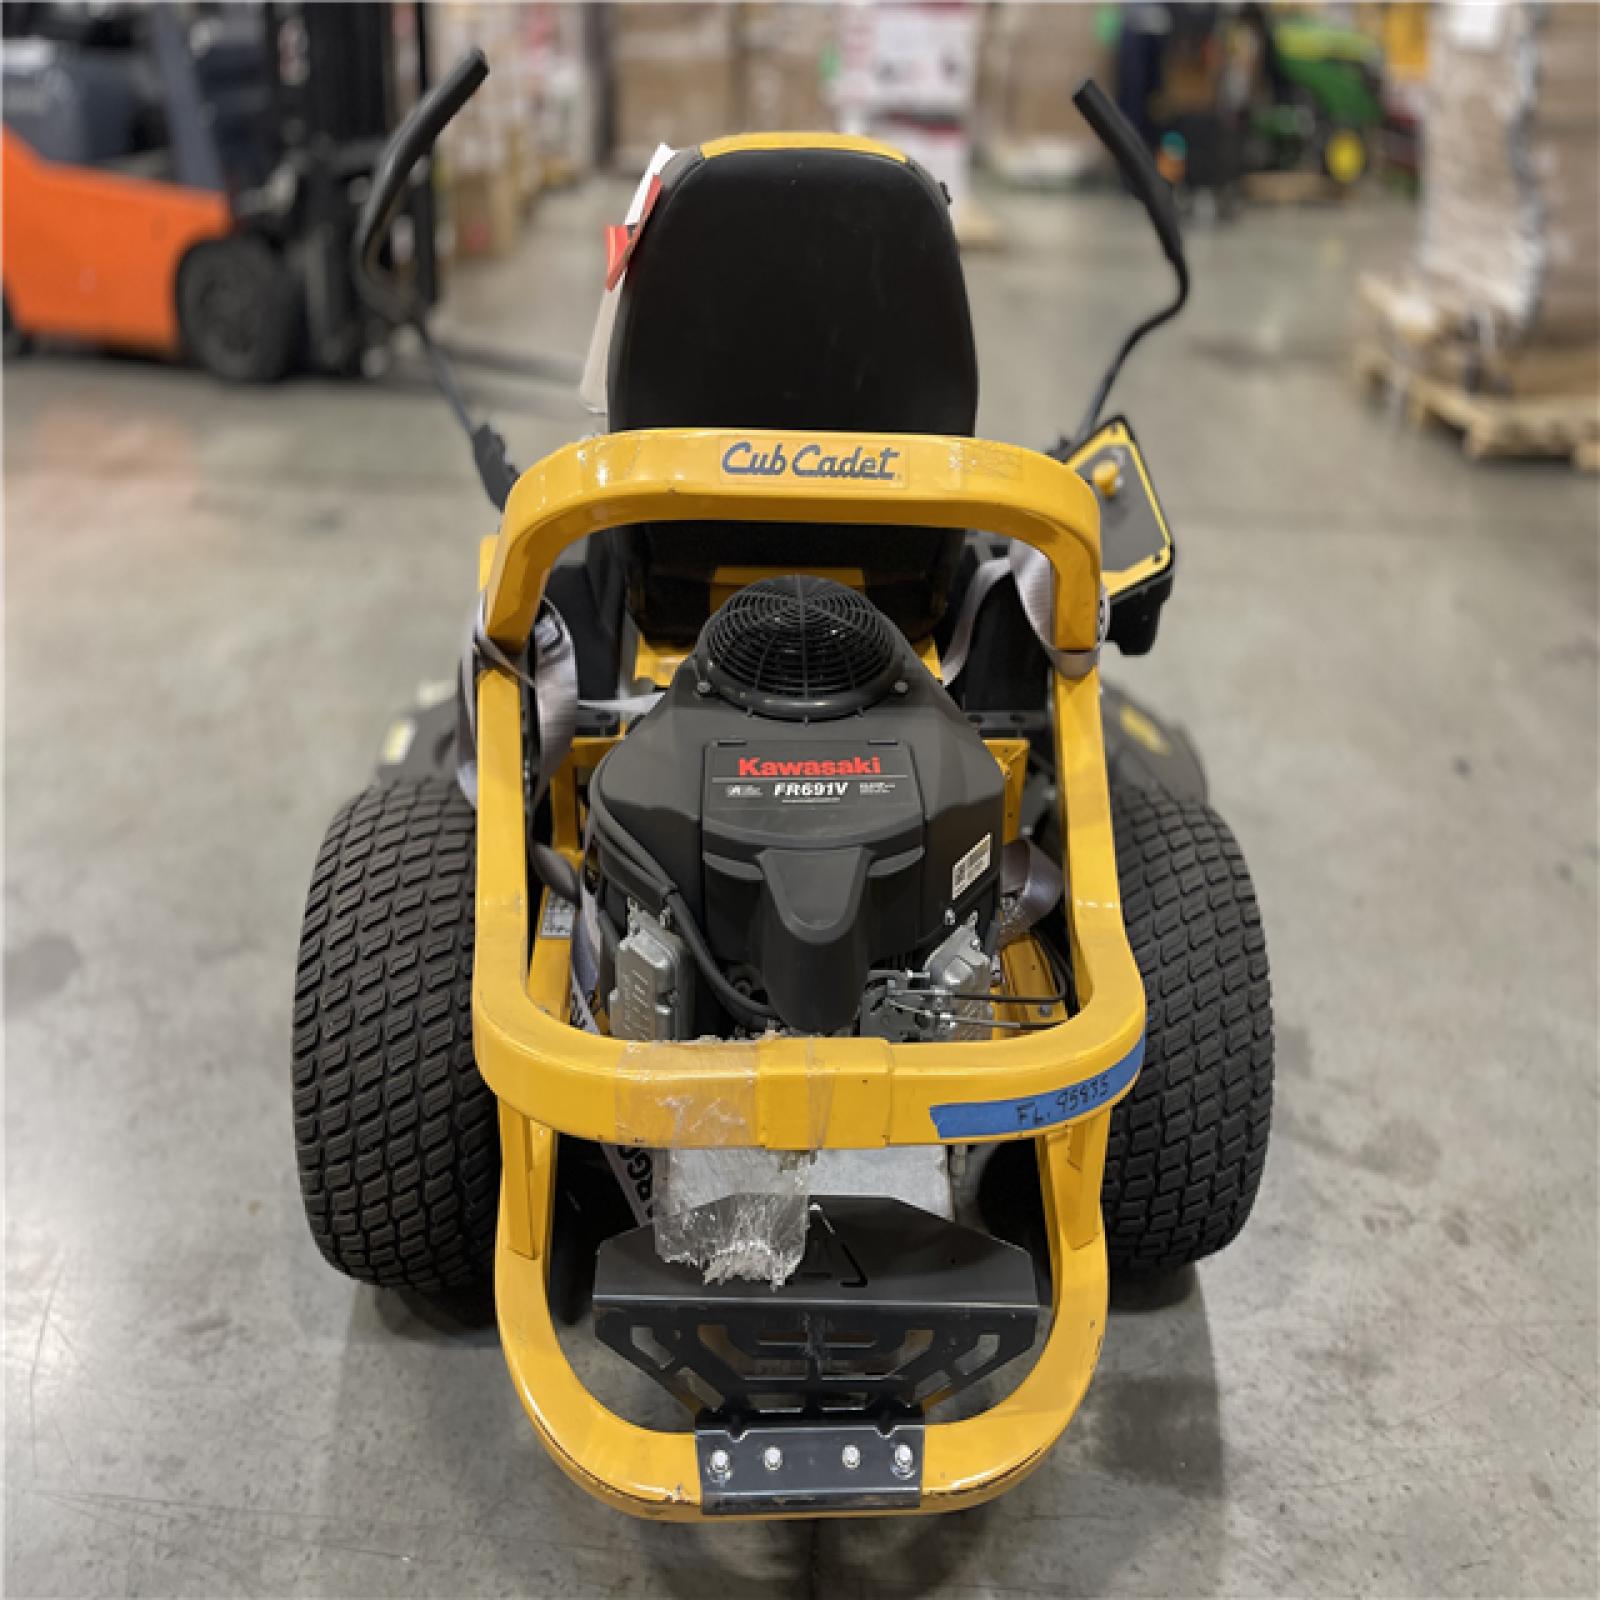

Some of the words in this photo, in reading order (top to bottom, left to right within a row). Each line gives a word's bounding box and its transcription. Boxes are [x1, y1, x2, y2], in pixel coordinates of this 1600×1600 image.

[721, 441, 787, 475] Cub
[792, 443, 900, 480] Cadet
[738, 754, 881, 777] Kawasaki
[774, 782, 849, 797] FR691V
